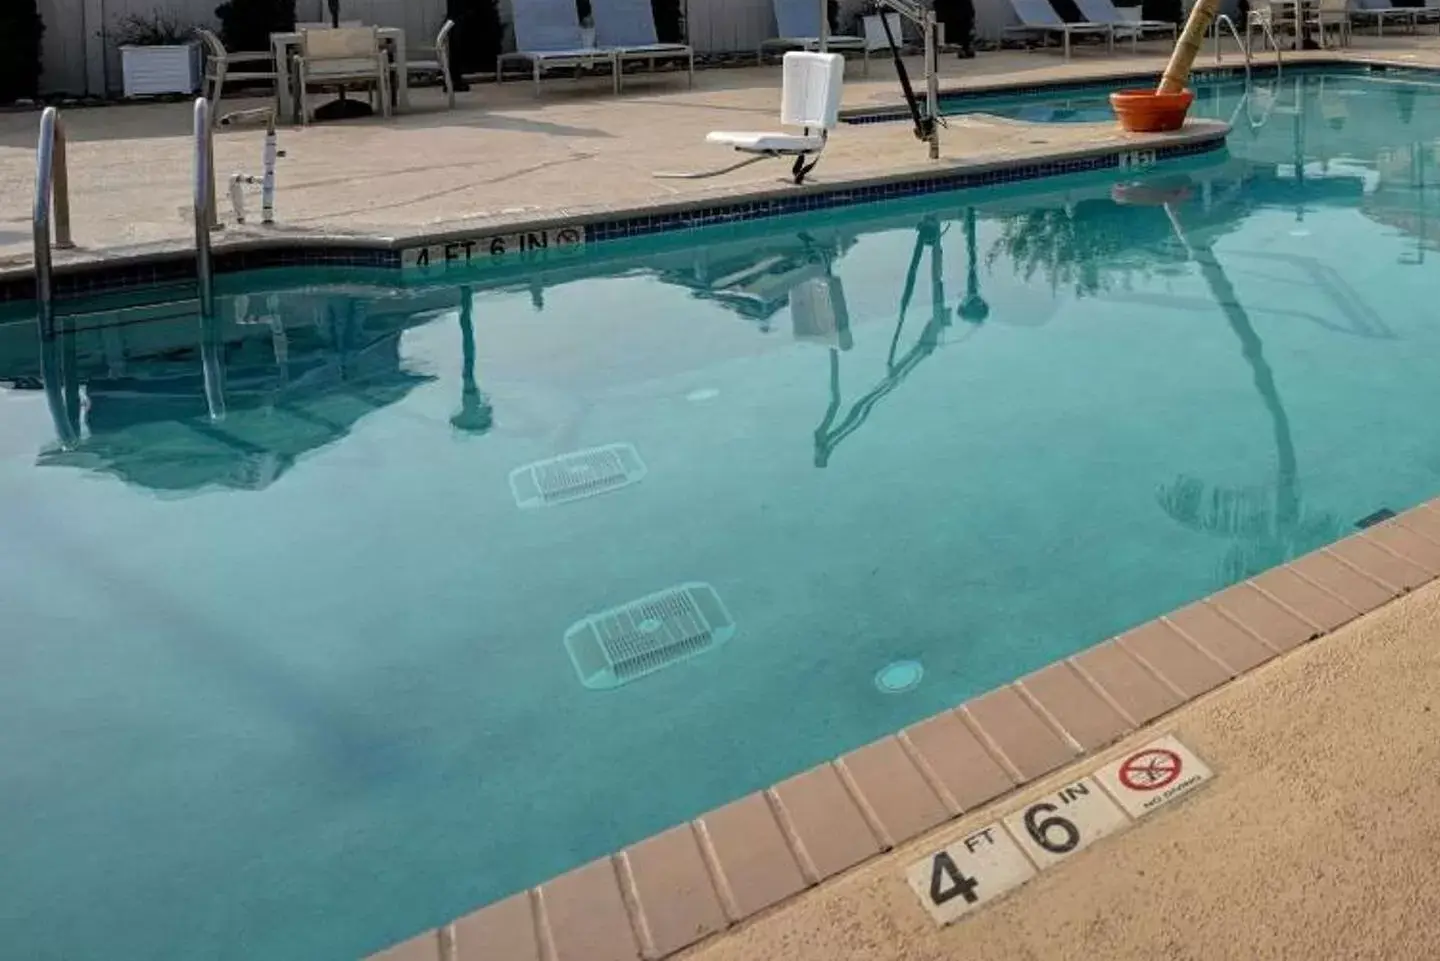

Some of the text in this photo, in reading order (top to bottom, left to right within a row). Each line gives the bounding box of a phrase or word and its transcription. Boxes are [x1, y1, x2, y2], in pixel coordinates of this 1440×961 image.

[930, 783, 1090, 905] 4 FT 6 IN
